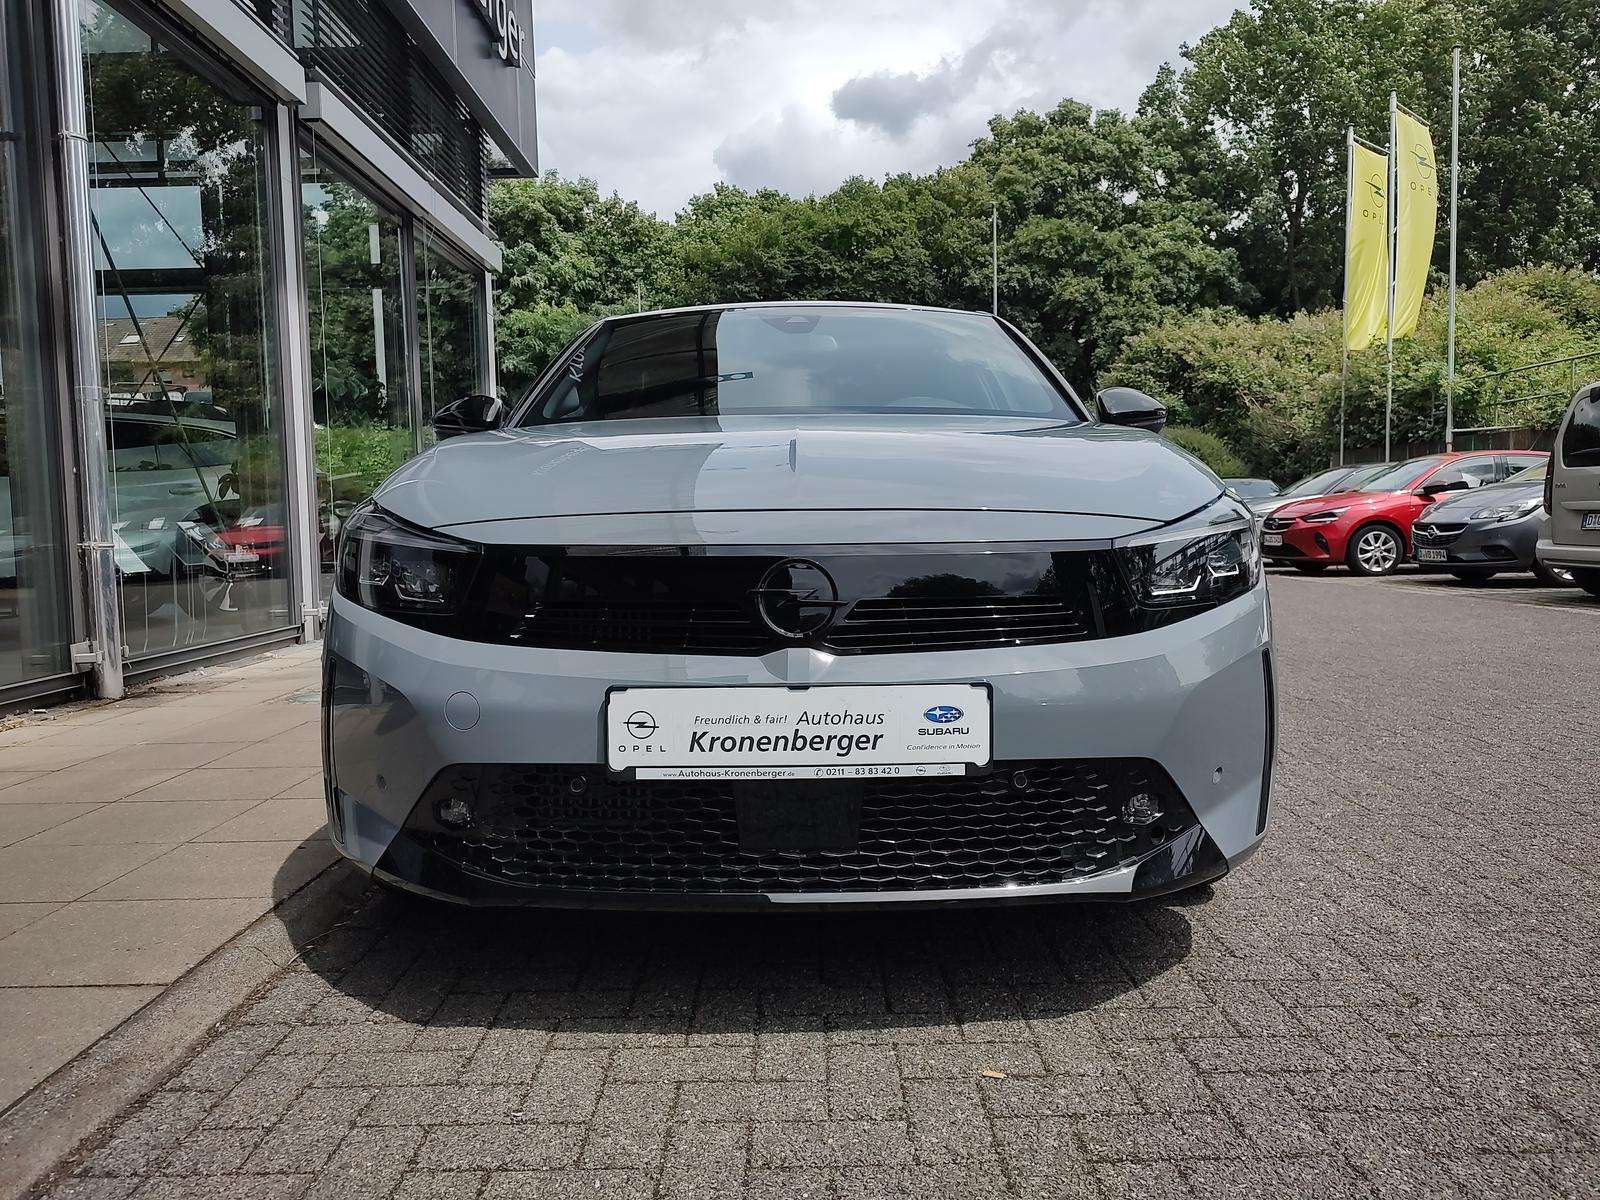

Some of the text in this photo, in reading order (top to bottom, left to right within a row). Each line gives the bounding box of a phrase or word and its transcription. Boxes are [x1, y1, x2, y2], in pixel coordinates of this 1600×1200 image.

[694, 714, 788, 725] Freundlich & fair!
[796, 709, 885, 726] Autohaus
[918, 727, 970, 736] SUBARU
[688, 728, 884, 757] Kronenberger
[618, 745, 667, 753] OPEL
[826, 768, 845, 776] 0211
